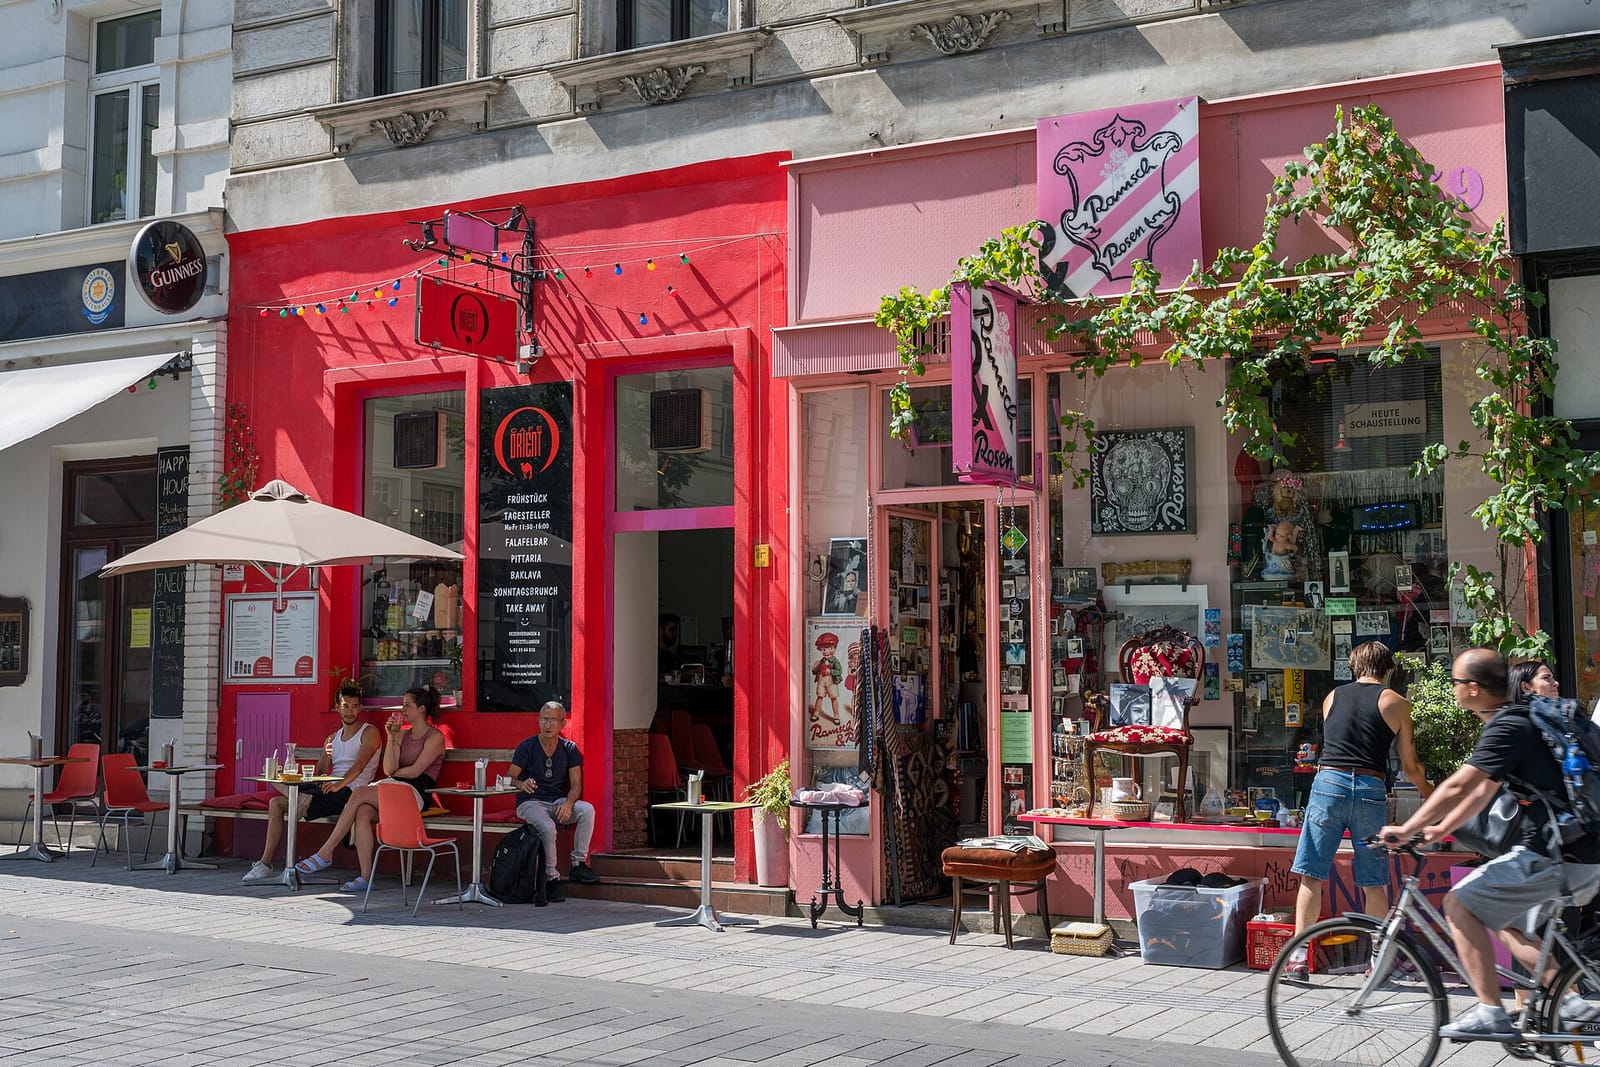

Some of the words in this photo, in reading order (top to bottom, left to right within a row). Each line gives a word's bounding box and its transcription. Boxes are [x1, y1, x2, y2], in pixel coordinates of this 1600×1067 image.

[1083, 157, 1158, 223] Ramsch
[1101, 223, 1146, 267] Rosen
[151, 257, 203, 288] GUINNESS
[972, 294, 1017, 436] Ramsch
[1371, 409, 1400, 418] HEUTE
[1350, 416, 1421, 429] SCHAUSTELLUNG
[510, 431, 543, 459] ORIENT
[974, 429, 1015, 472] Rosen
[160, 455, 190, 475] HAPPY
[507, 493, 548, 504] FRÜHSTÜCK
[1161, 461, 1185, 527] Rosen
[503, 510, 550, 521] TAGESTELLER
[505, 537, 548, 547] FALAFELBAR
[510, 553, 542, 564] PITTARIA
[510, 570, 542, 580] BAKLAVA
[493, 586, 558, 597] SONNTAGSBRUNCH
[505, 604, 524, 613] TAKE
[525, 603, 545, 613] AWAY
[810, 719, 854, 742] Ramsch
[835, 733, 846, 747] &
